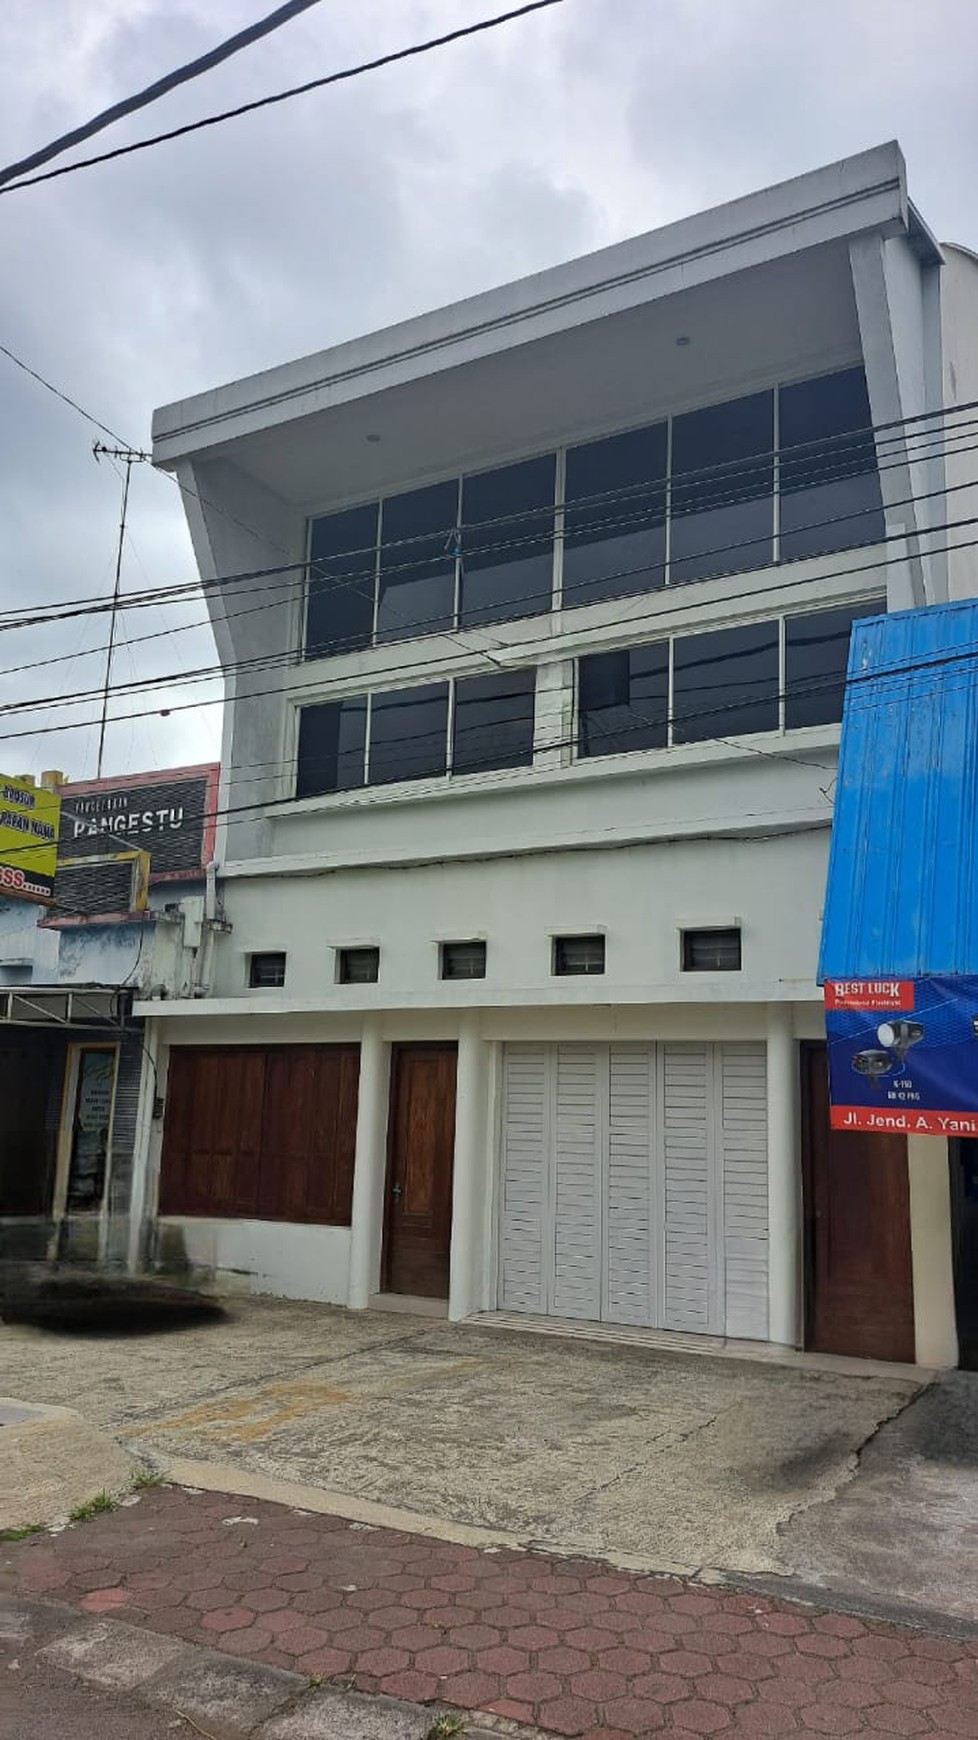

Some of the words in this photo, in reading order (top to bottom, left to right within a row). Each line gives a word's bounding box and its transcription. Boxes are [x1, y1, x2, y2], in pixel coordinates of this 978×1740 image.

[74, 807, 183, 838] PANGESTU
[835, 982, 864, 997] BEST
[868, 982, 899, 997] LUCK
[843, 1112, 862, 1125] Jl.
[867, 1114, 911, 1128] Jend.
[916, 1117, 933, 1129] A.
[938, 1117, 976, 1131] Yani
